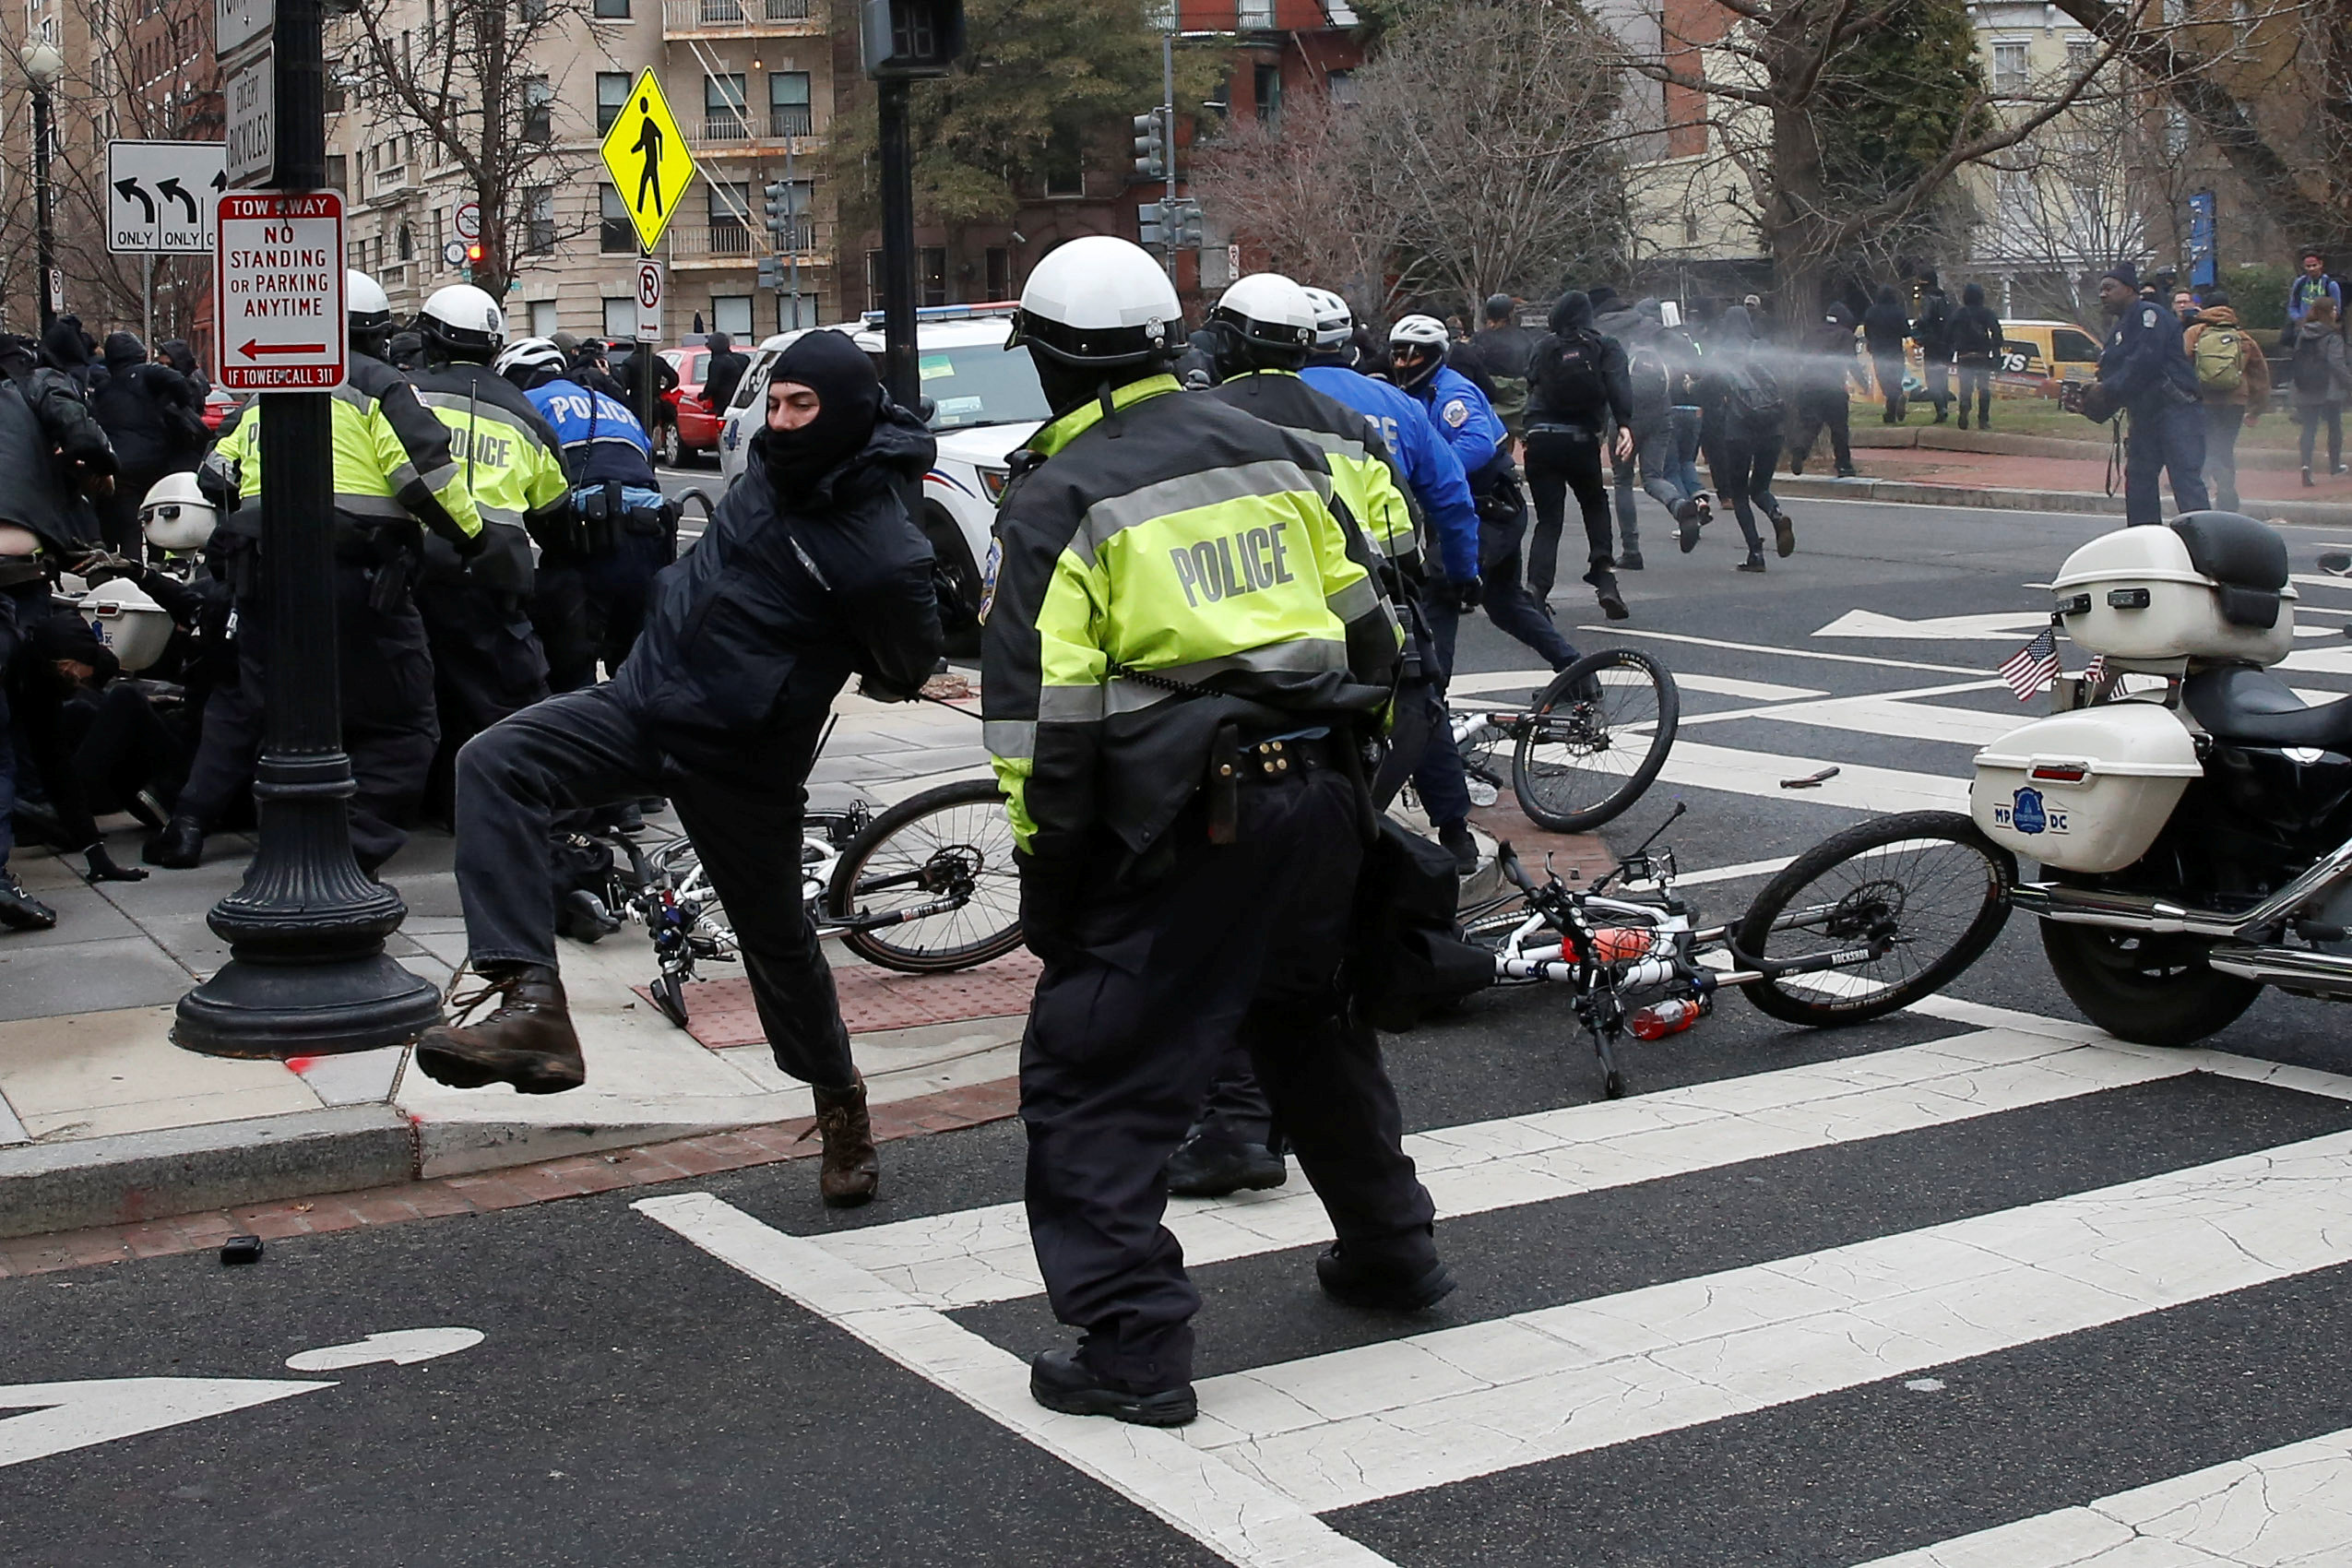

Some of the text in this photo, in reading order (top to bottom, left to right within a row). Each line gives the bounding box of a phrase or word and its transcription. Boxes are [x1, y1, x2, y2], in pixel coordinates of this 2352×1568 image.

[236, 75, 259, 113] EXCEPT
[230, 112, 268, 168] BICYCLES
[232, 199, 269, 216] TOW
[117, 231, 153, 245] ONLY
[164, 232, 200, 246] ONLY
[264, 226, 294, 244] NO
[230, 248, 327, 268] STANDING
[231, 272, 328, 293] OR PARKING
[244, 297, 323, 317] ANYTIME
[228, 367, 333, 386] IF TOWED CALL 311
[451, 426, 512, 469] OICE
[1169, 522, 1295, 608] POLICE
[1994, 808, 2068, 829] MP DC
